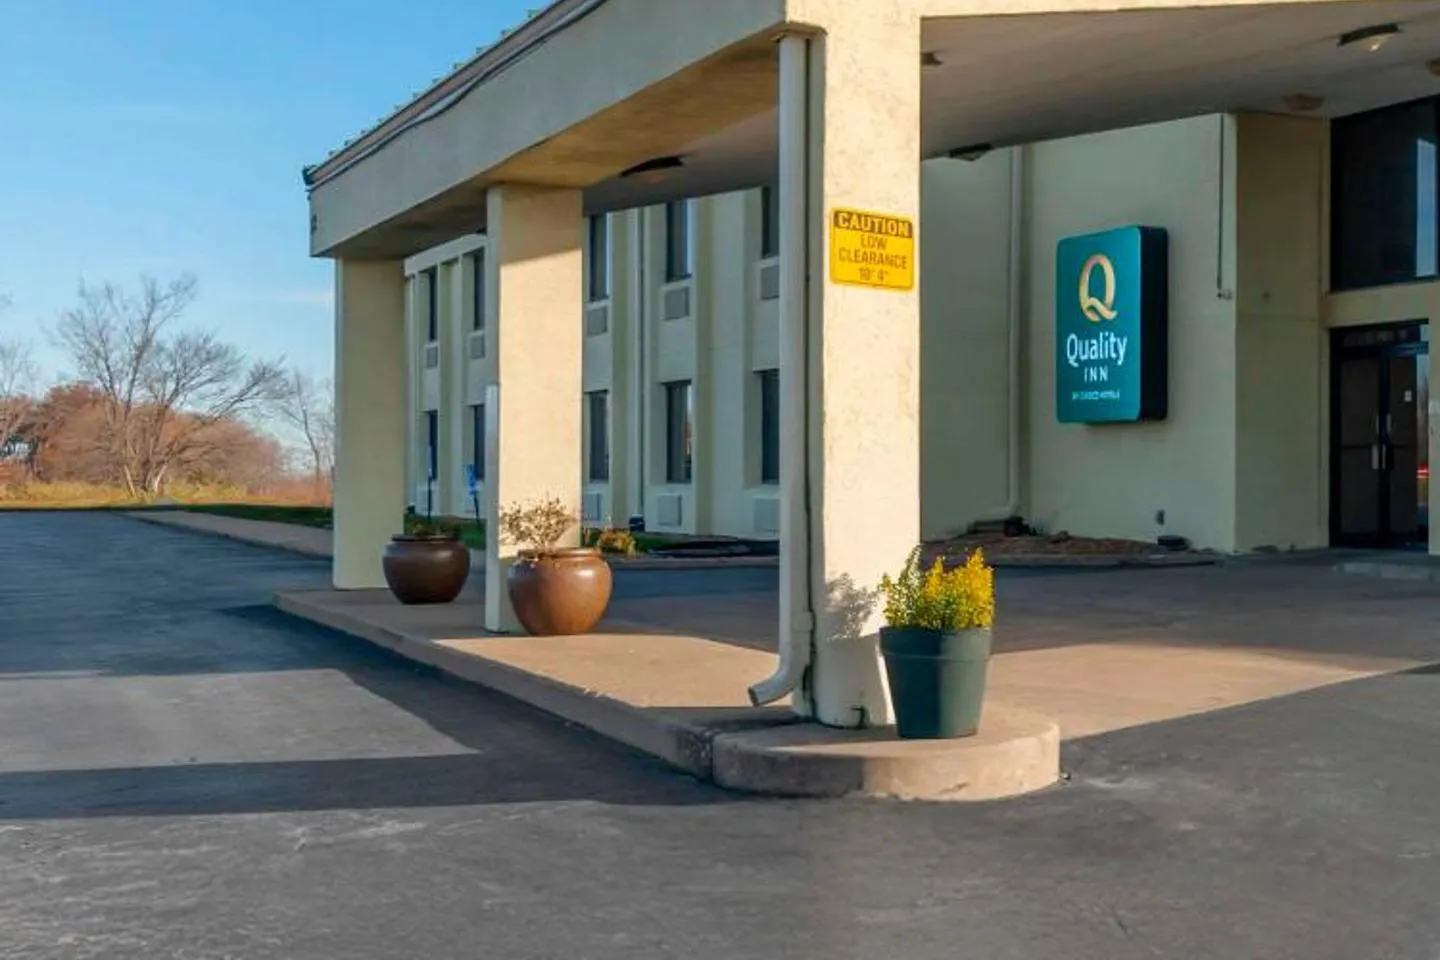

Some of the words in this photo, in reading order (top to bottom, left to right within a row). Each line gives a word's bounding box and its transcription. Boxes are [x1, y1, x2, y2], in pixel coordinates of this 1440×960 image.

[838, 212, 909, 237] CAUTION
[860, 234, 888, 250] LOW
[838, 246, 907, 269] CLEARANCE
[1078, 253, 1117, 322] Q
[1066, 331, 1127, 367] Quality
[1084, 365, 1108, 382] INN
